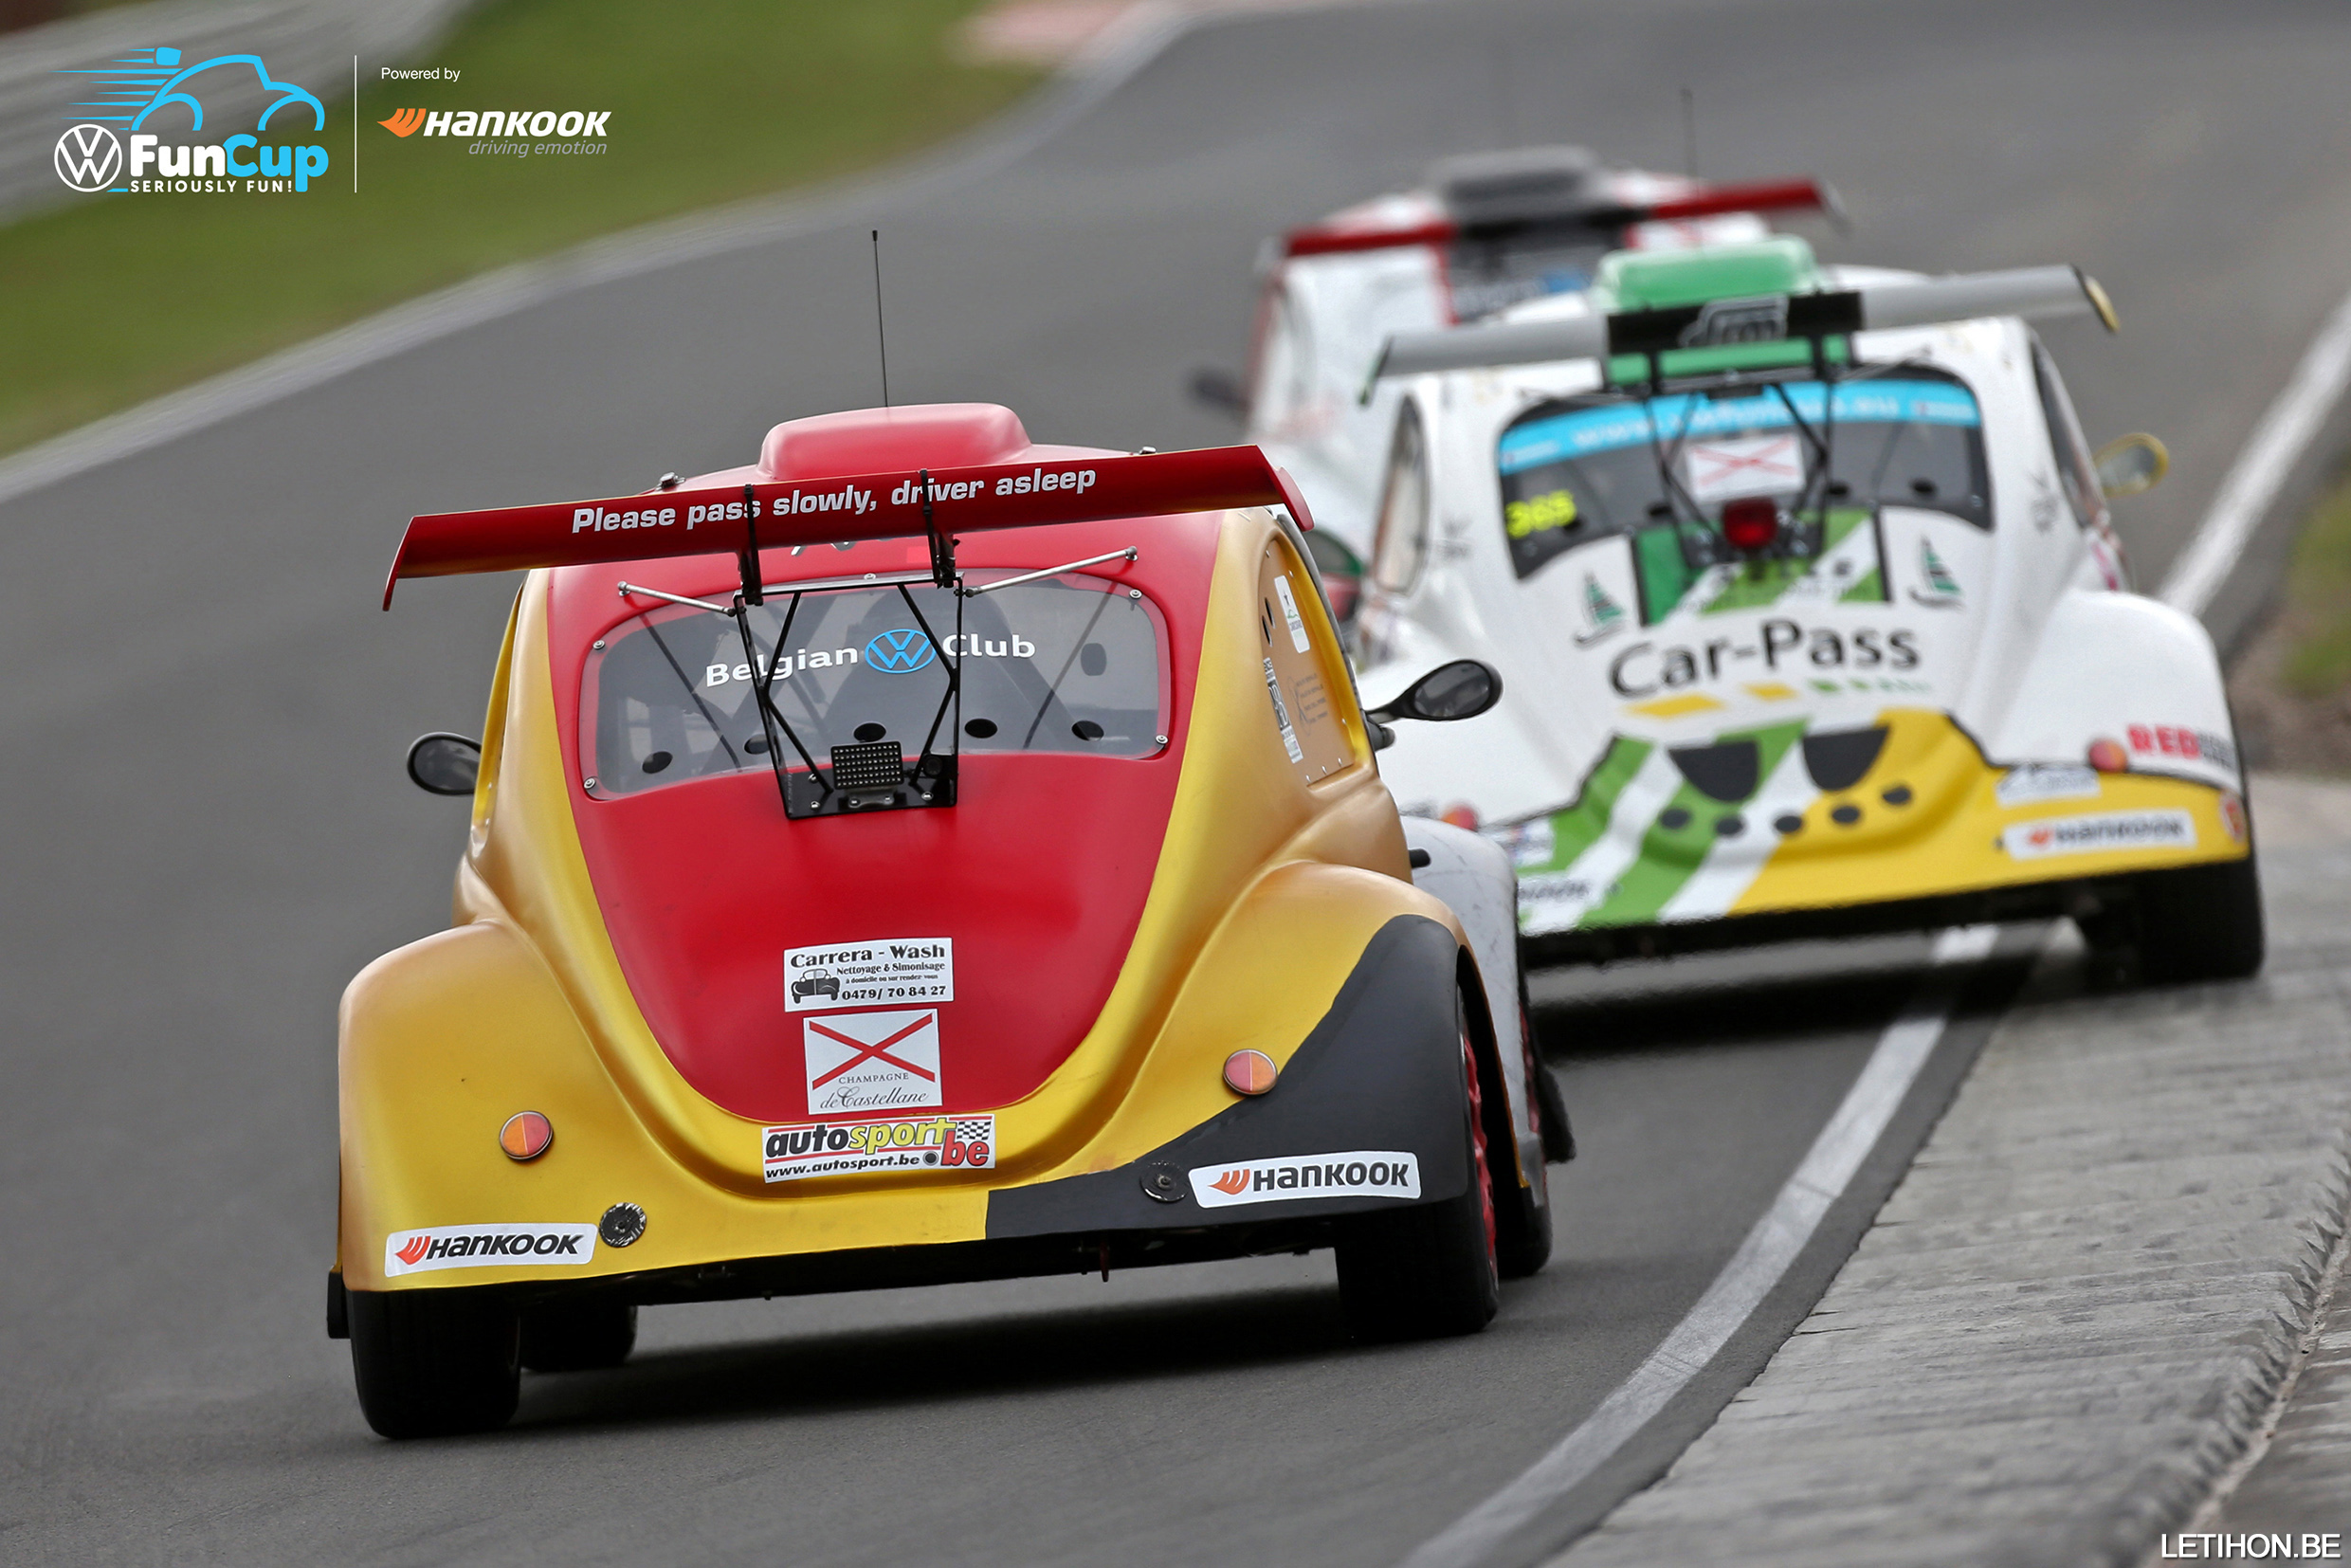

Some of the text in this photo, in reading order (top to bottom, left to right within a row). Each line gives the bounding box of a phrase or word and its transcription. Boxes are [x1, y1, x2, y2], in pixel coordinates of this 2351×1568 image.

[572, 467, 1096, 534] Please pass slowly, driver asleep
[705, 645, 859, 687] Belgian
[942, 633, 1036, 658] Club
[1610, 619, 1921, 700] Car-Pass
[791, 949, 872, 968] Carrera
[889, 944, 945, 959] Wash
[836, 960, 945, 975] Nettoyage & Simonisage
[842, 986, 946, 1000] 0479/ 70 84 27
[838, 1072, 909, 1084] CHAMPAGNE
[765, 1118, 957, 1158] autosport
[765, 1153, 920, 1179] www.autosport.be
